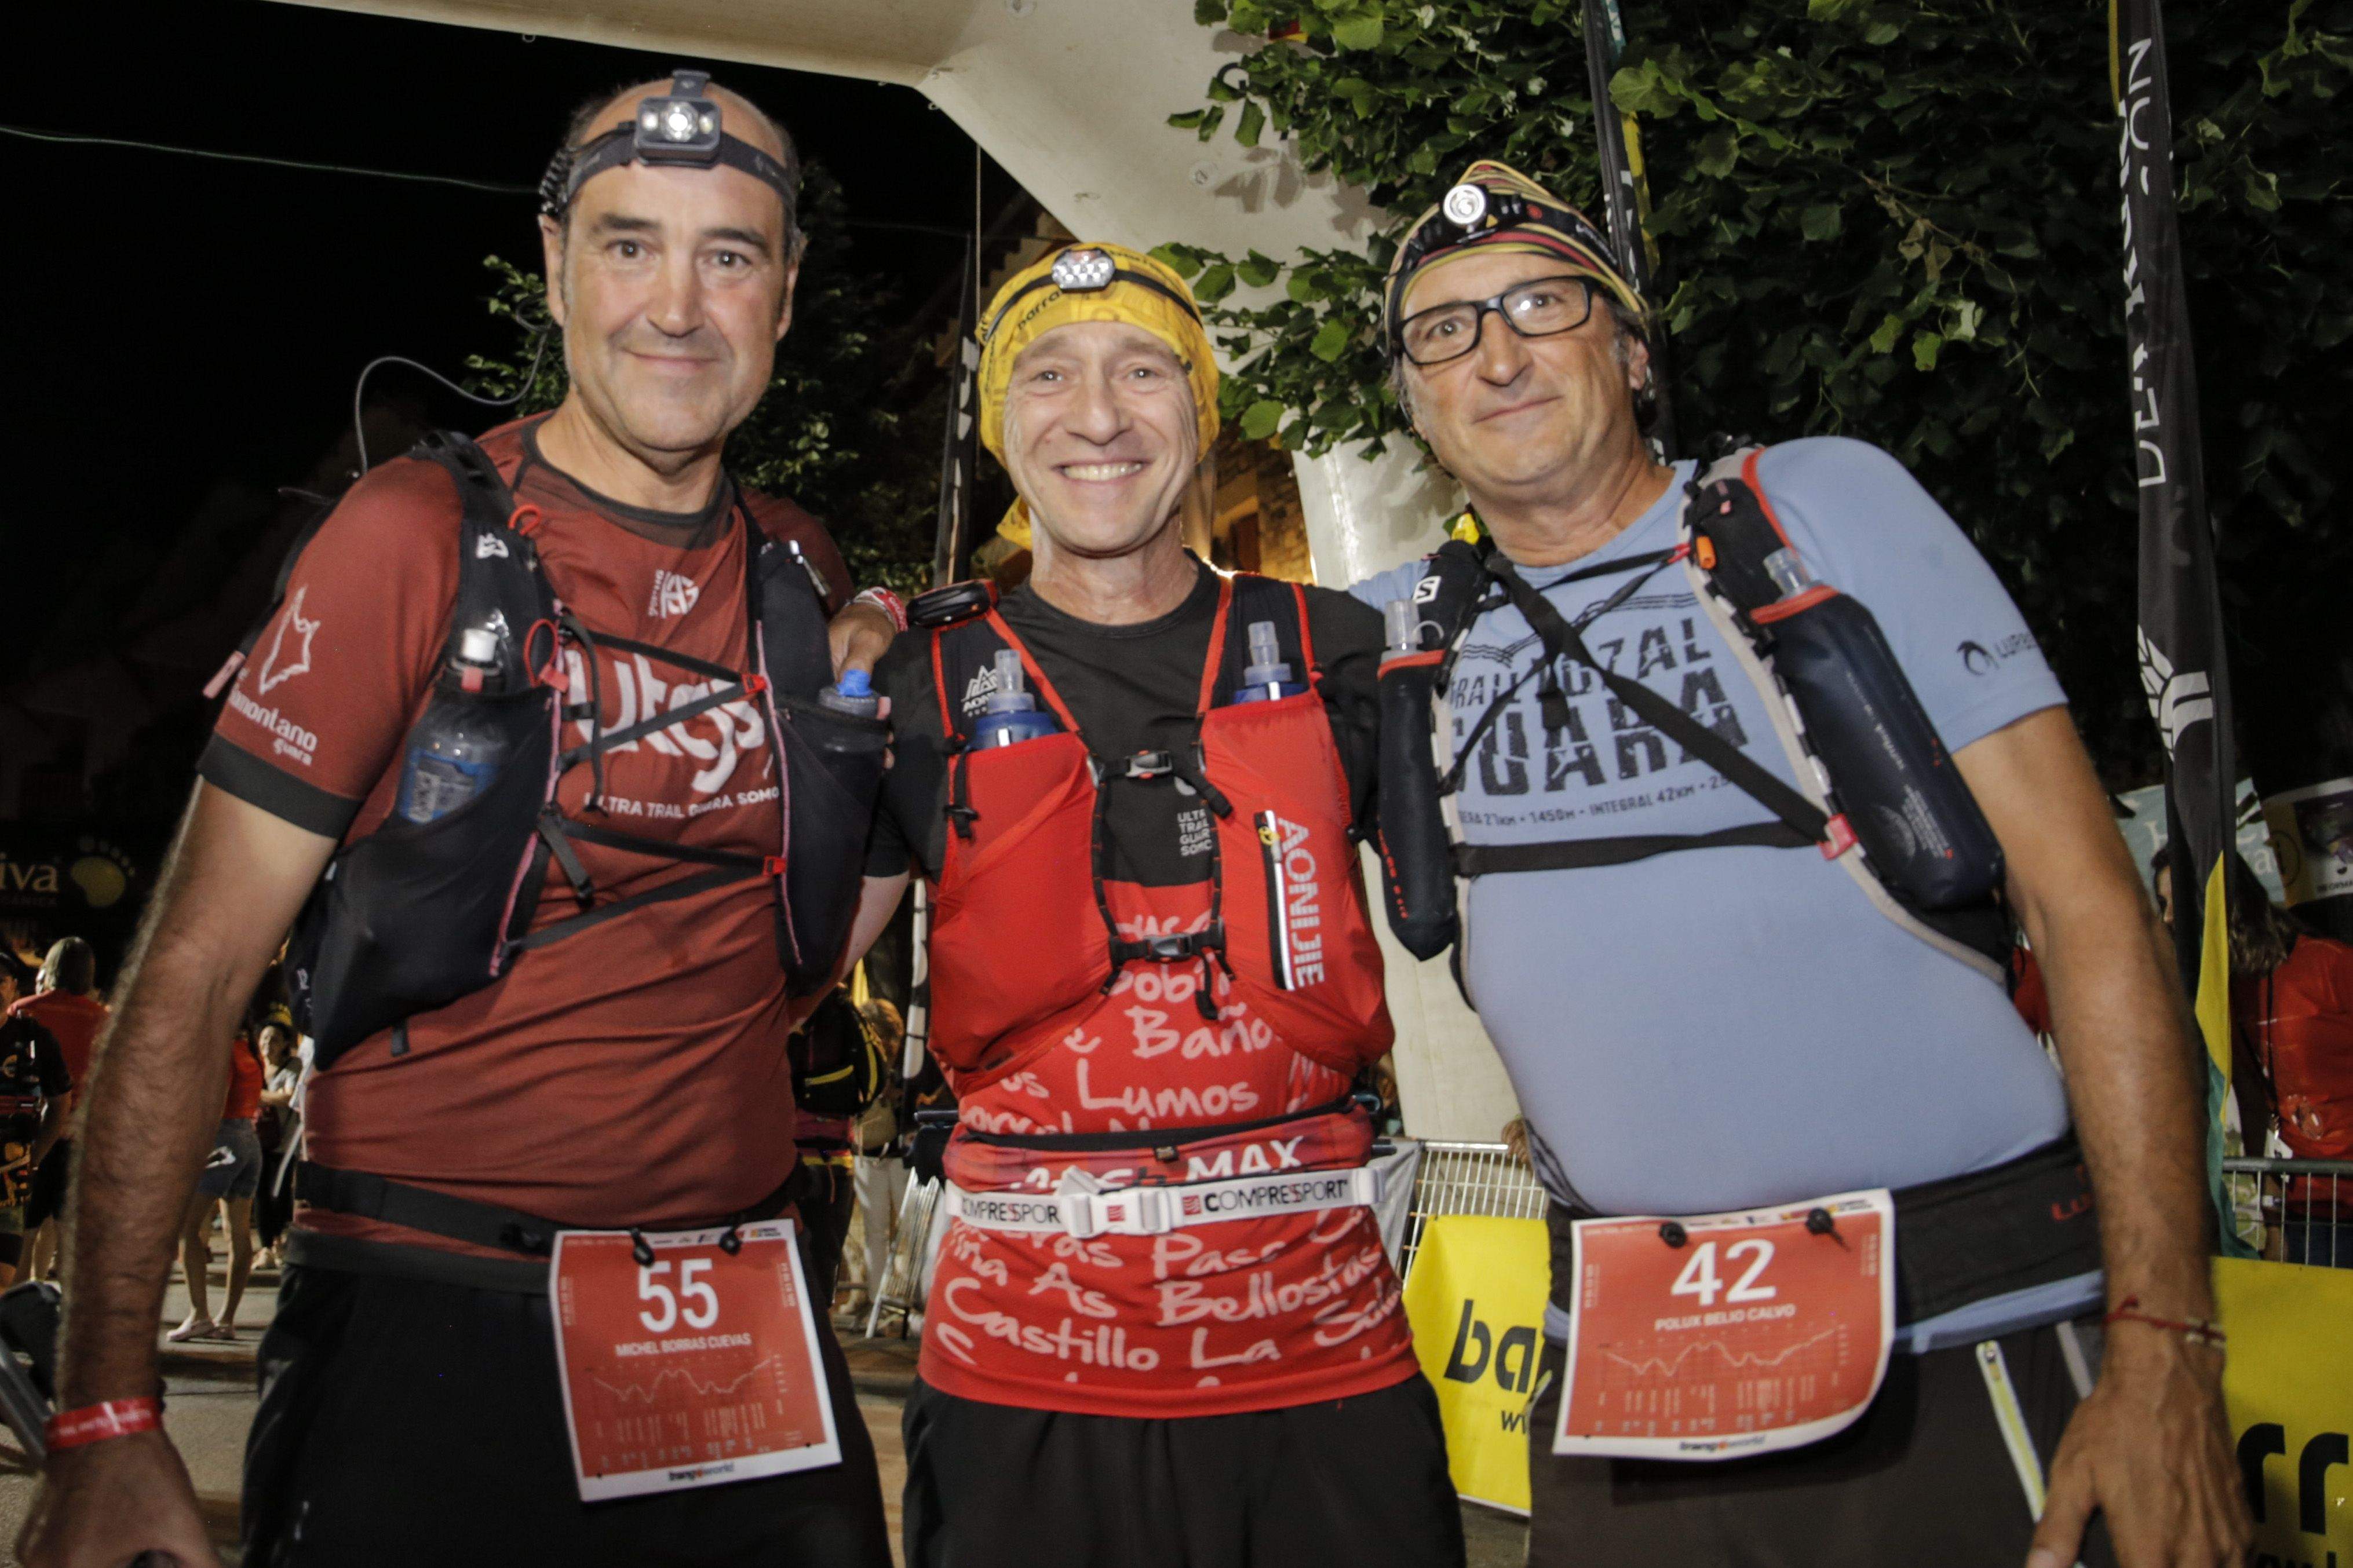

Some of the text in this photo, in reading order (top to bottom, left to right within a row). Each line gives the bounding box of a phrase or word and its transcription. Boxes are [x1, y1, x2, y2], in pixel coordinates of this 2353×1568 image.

[647, 801, 685, 819] TRAIL
[1589, 793, 1654, 816] INTEGRAL
[1276, 816, 1325, 988] AONIJIE
[1077, 1058, 1259, 1119] Lumos
[1185, 1135, 1305, 1182] MAX
[637, 1258, 720, 1333] 55
[1027, 1262, 1119, 1318] As
[1152, 1245, 1381, 1326] Bellostas
[1670, 1238, 1777, 1307] 42
[944, 1277, 1283, 1372] Castillo La
[1655, 1315, 1701, 1332] POLUX
[1746, 1303, 1796, 1322] CALVO
